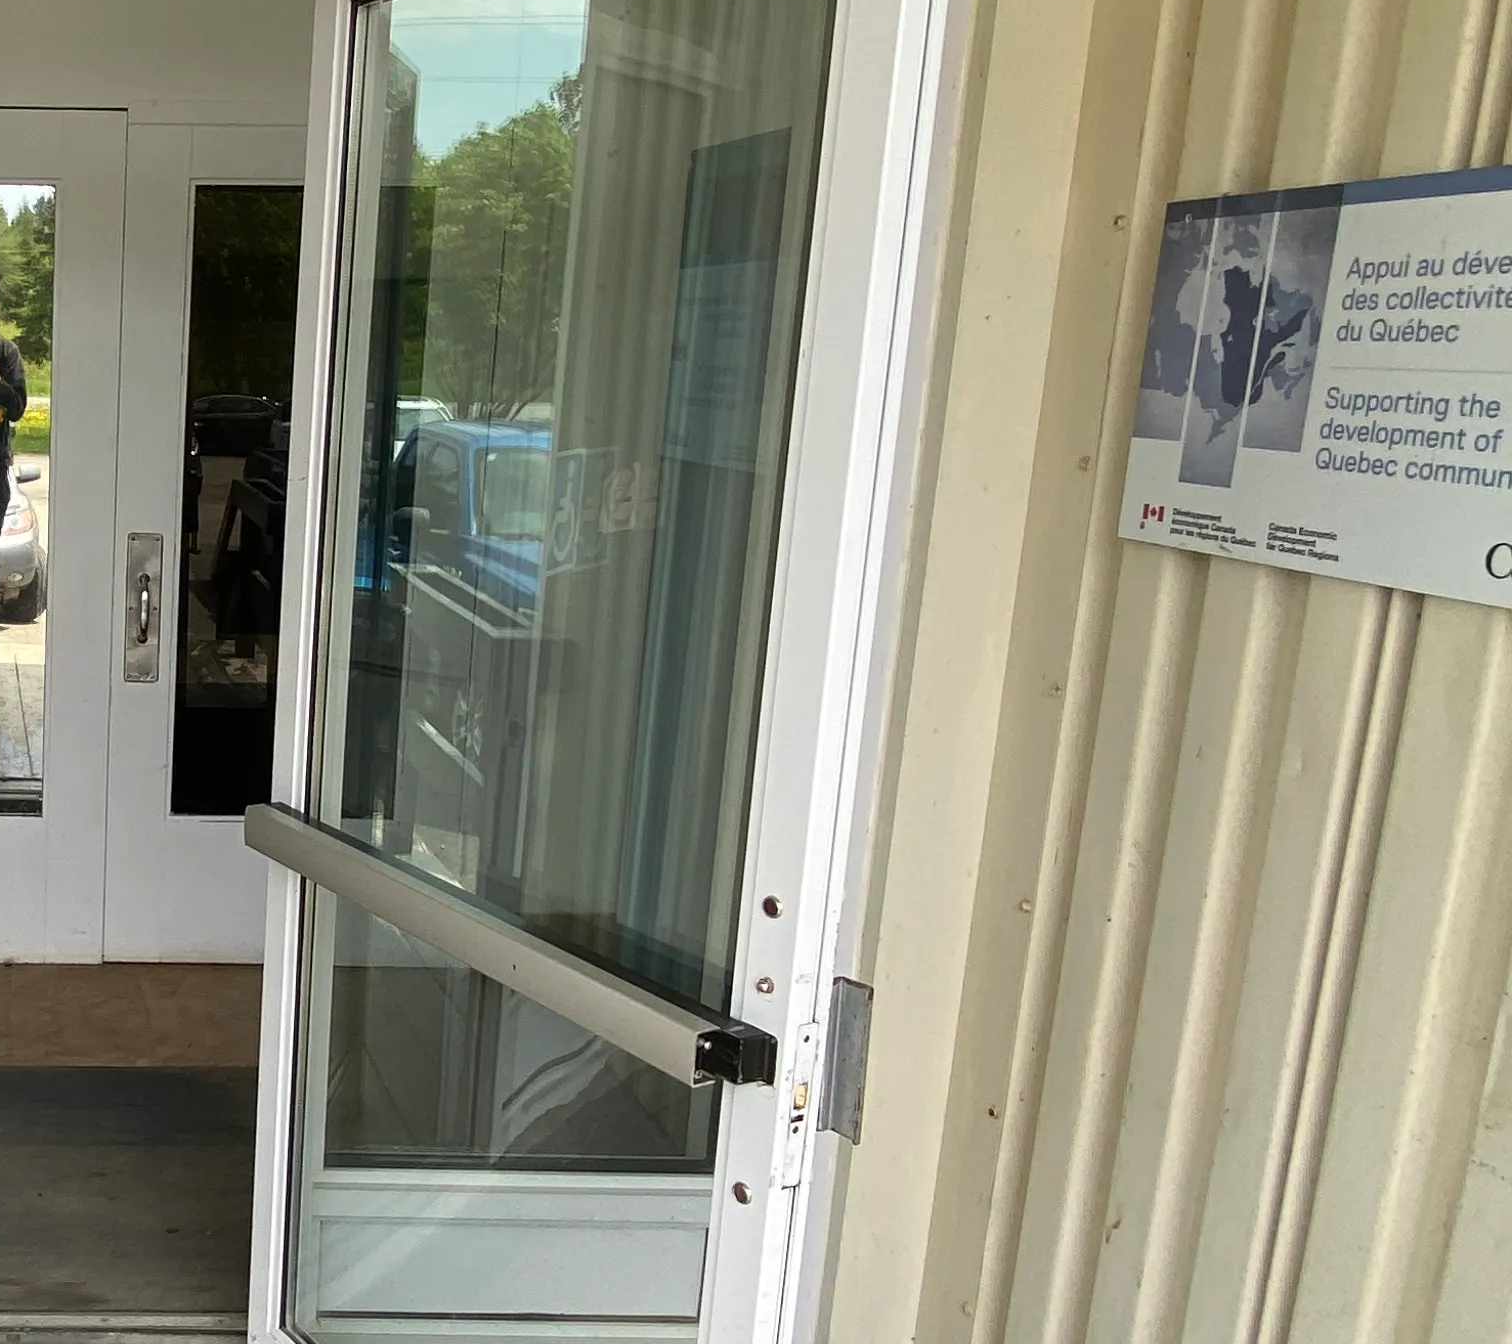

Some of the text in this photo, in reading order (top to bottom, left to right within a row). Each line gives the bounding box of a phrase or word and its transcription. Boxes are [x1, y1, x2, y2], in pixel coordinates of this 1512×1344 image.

[1346, 250, 1512, 286] Appui au déve
[1341, 288, 1379, 311] des
[1336, 318, 1460, 343] du Québec
[1324, 386, 1502, 423] Supporting the
[1319, 417, 1505, 454] development of
[1315, 447, 1512, 490] Quebec commun
[1485, 542, 1512, 579] C
